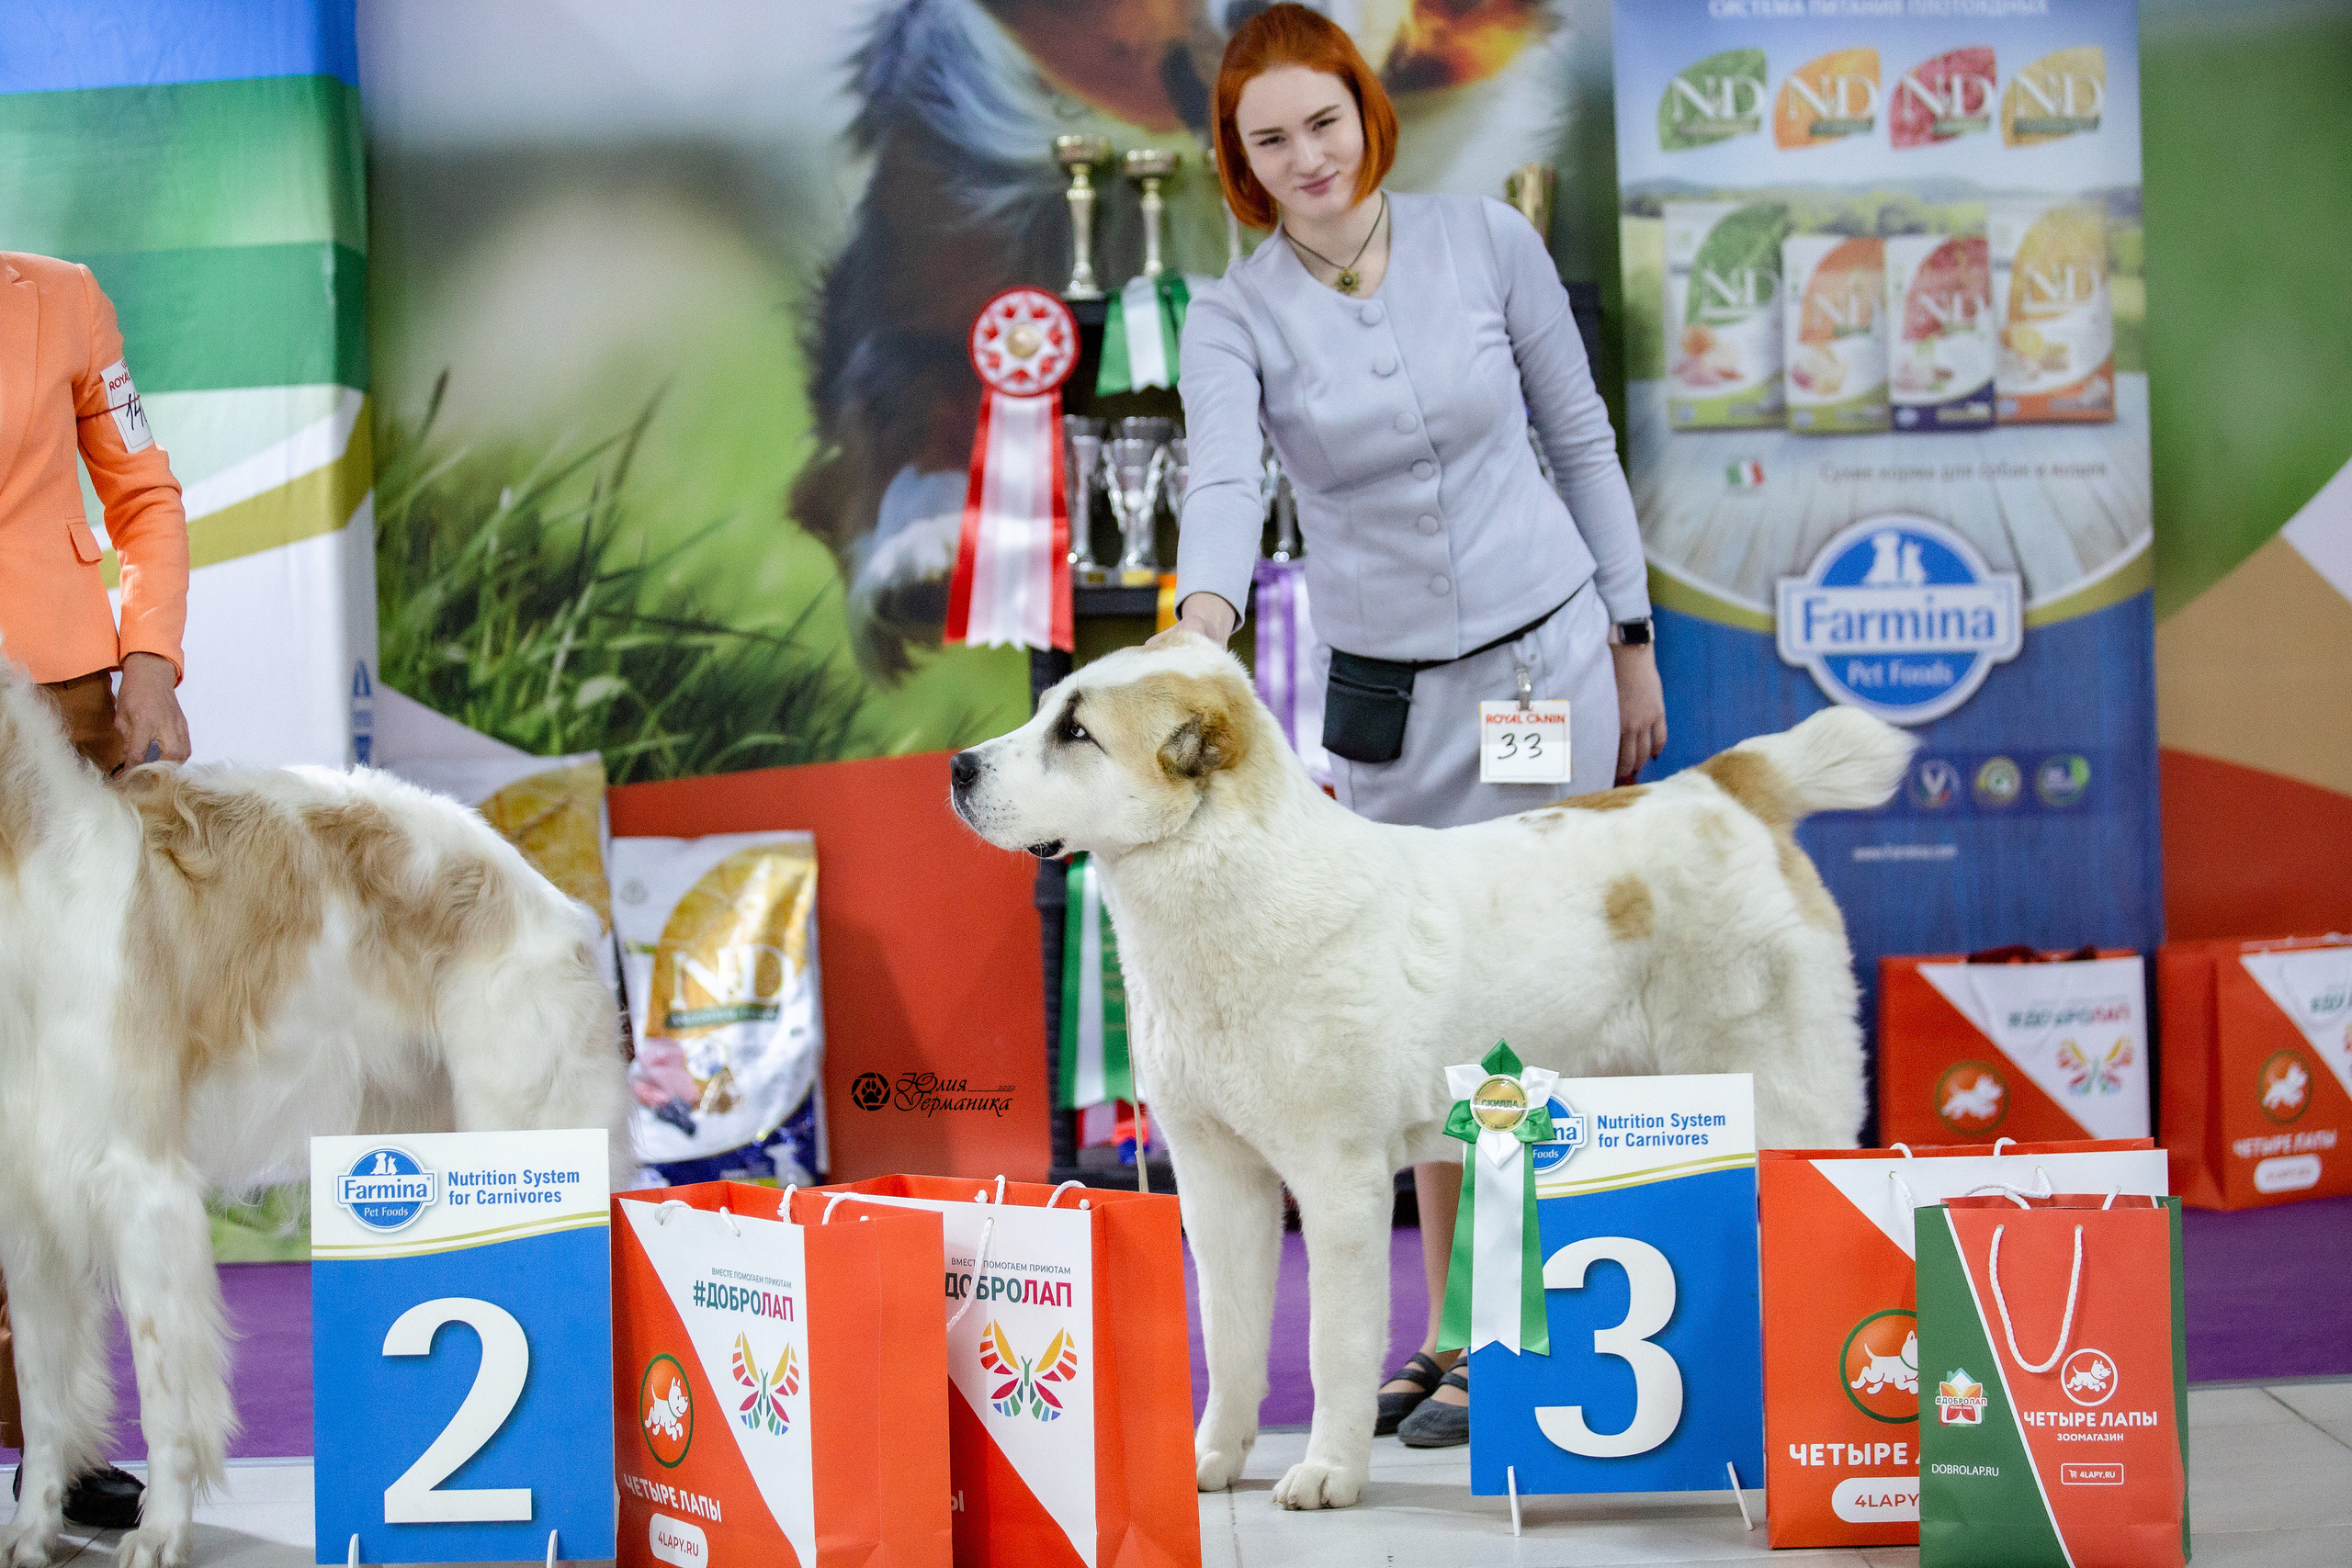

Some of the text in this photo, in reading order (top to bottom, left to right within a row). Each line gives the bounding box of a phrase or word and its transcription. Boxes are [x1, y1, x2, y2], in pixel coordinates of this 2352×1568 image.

[1804, 594, 1995, 643] Farmina
[1847, 658, 1955, 688] Pet Foods
[1486, 714, 1566, 724] ROYAL CANIN
[1498, 732, 1543, 760] 33
[1597, 1112, 1725, 1131] Nutrition System
[1599, 1132, 1709, 1147] for Carnivores
[1532, 1149, 1559, 1158] Foods
[448, 1169, 580, 1187] Nutrition System
[345, 1179, 427, 1200] Farmina
[448, 1189, 562, 1205] for Carnivores
[364, 1207, 408, 1217] Pet Foods
[951, 1258, 1071, 1274] ВМЕСТ ПОМОГАЕМ ПРИЮТАМ
[712, 1268, 792, 1289] ВМЕСТЕ ПОМОГАЕМ ПРИЮТАМ
[945, 1272, 1072, 1307] ДОБРОЛАП
[693, 1280, 794, 1322] #ДОБРОЛАП
[1534, 1236, 1683, 1458] 3
[1936, 1396, 1987, 1405] #ДОБРОЛАП
[382, 1297, 532, 1524] 2
[2024, 1411, 2158, 1427] ЧЕТЫРЕ ЛАПЫ
[2057, 1433, 2124, 1441] ЗООМАГАЗИН
[1789, 1442, 1908, 1466] ЧЕТЫРЕ
[1931, 1463, 1999, 1476] DOBROLAP.RU
[2079, 1471, 2116, 1479] 4LAPY.RU
[624, 1473, 722, 1523] ЧЕТЫРЕ ЛАПЫ
[1854, 1494, 1920, 1507] 4LAPY
[658, 1530, 699, 1557] 4LAPY.RU
